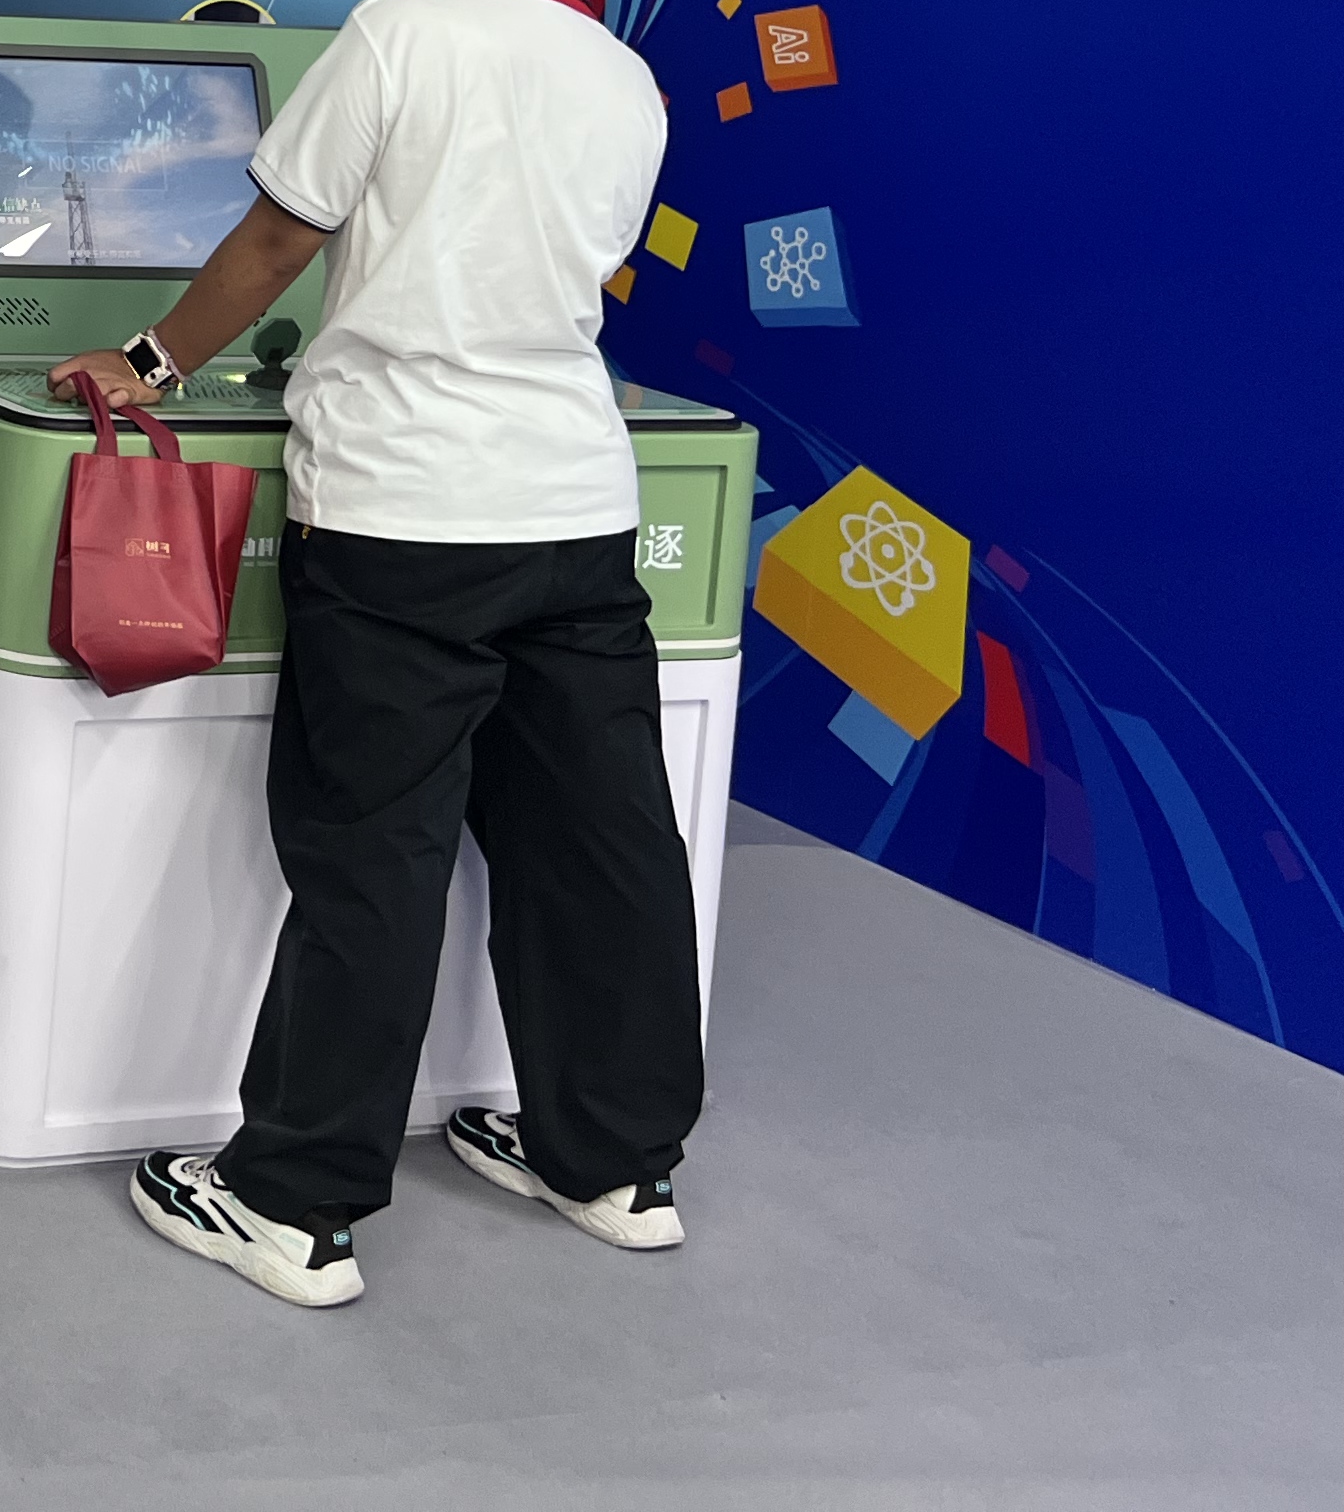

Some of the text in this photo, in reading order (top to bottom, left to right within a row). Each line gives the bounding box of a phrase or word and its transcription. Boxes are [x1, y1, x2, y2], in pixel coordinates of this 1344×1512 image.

[48, 155, 146, 174] NO SIGNAL
[635, 523, 684, 570] 逐
